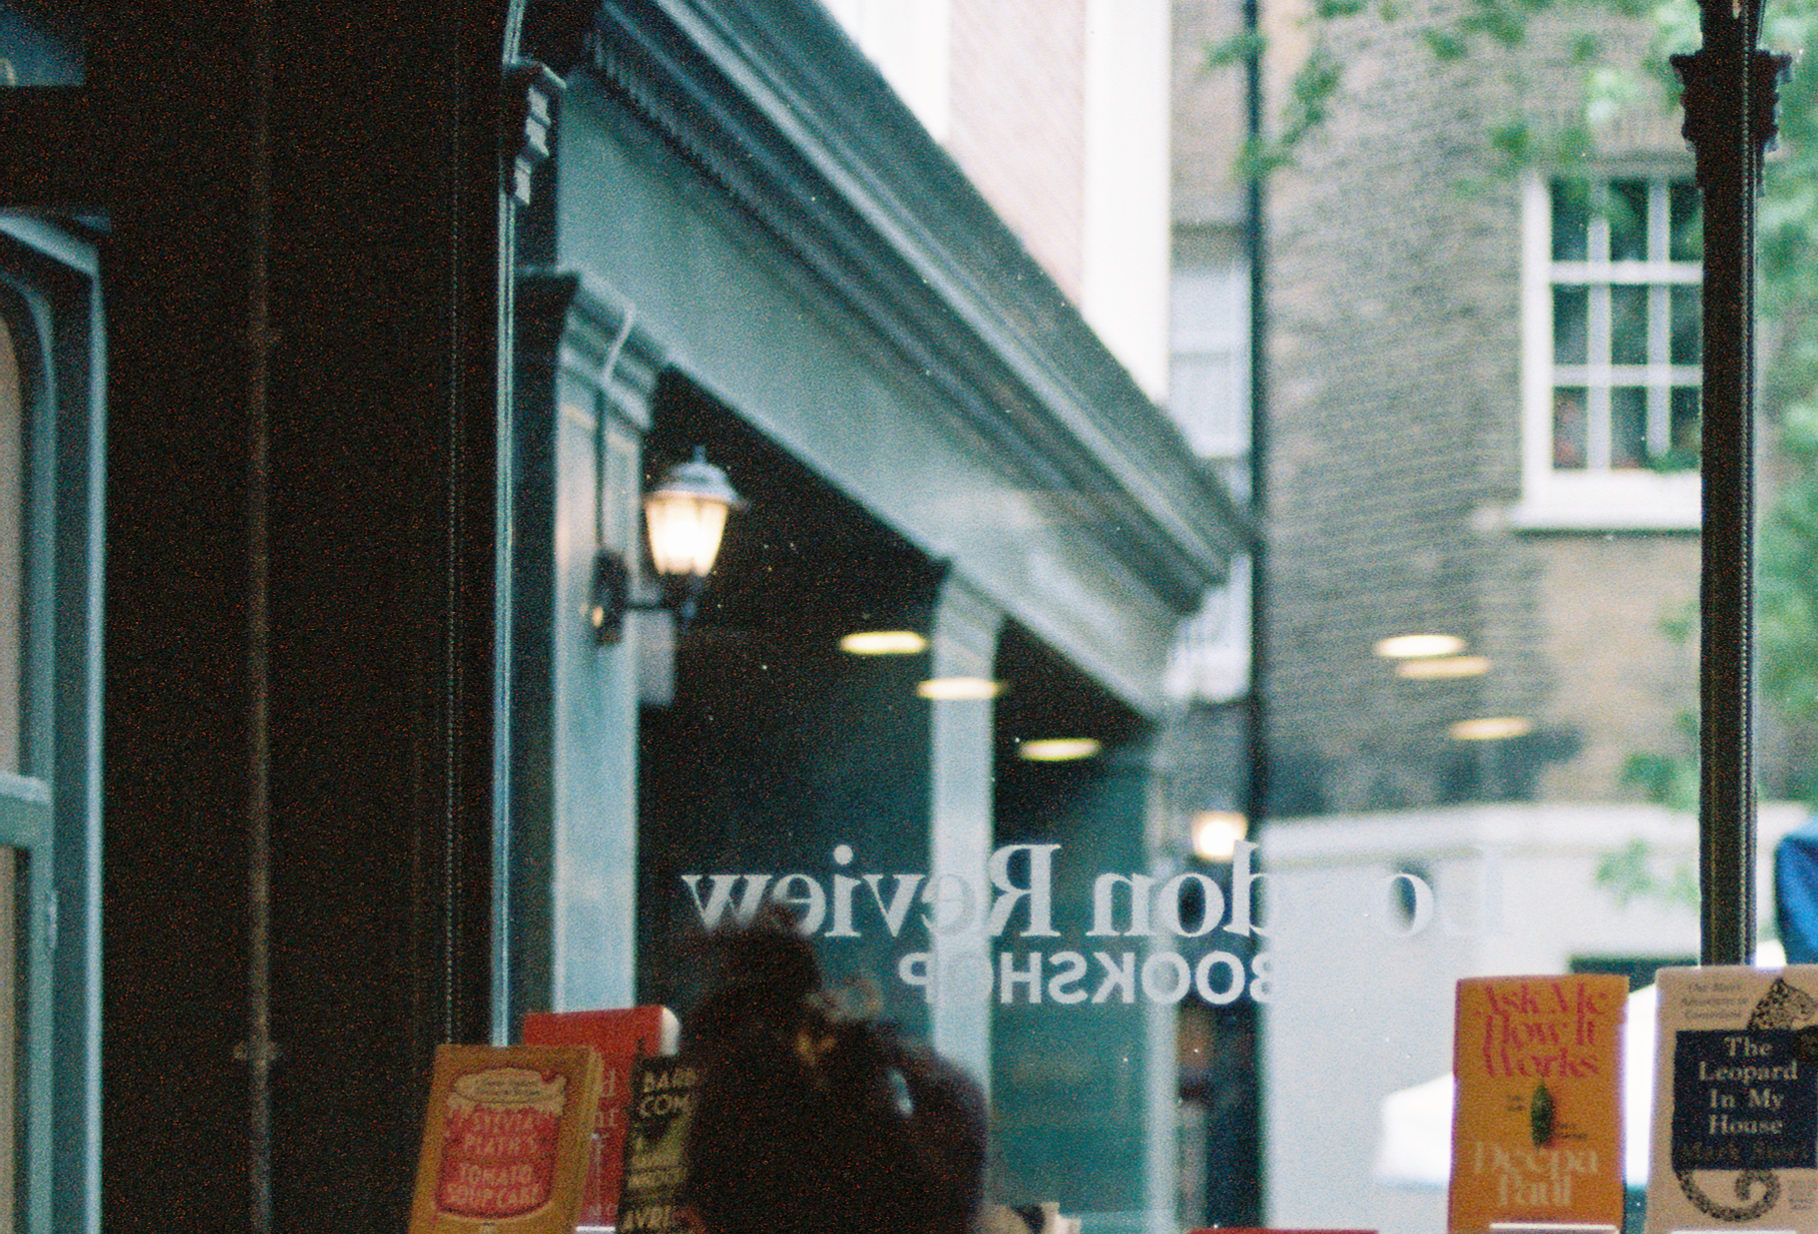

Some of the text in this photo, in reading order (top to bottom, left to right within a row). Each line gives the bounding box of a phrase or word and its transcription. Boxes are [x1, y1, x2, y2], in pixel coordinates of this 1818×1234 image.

[1724, 1035, 1773, 1057] The
[1483, 1047, 1599, 1078] Works
[1698, 1059, 1799, 1084] Leopard
[1709, 1087, 1785, 1111] In My
[1708, 1113, 1784, 1135] House
[459, 1162, 535, 1185] TOMATO
